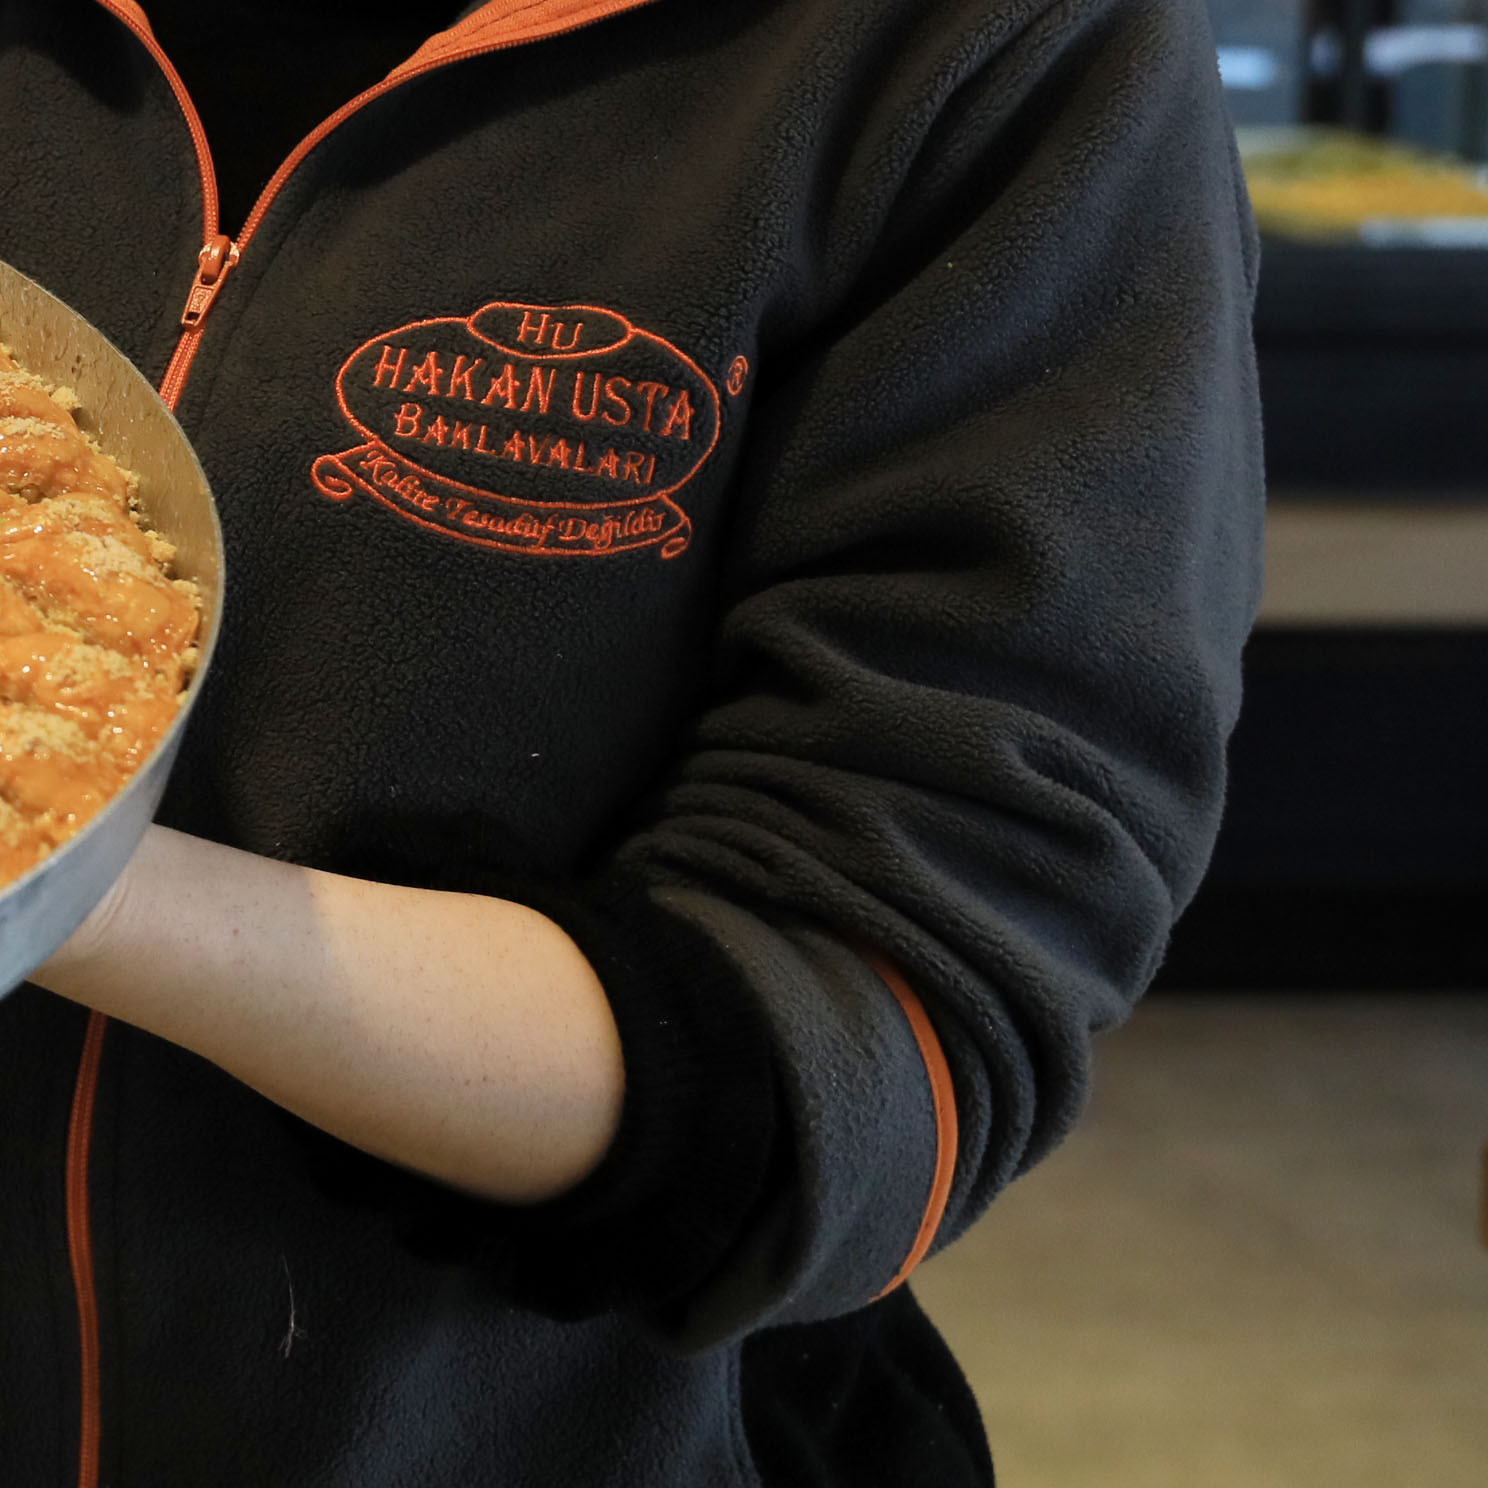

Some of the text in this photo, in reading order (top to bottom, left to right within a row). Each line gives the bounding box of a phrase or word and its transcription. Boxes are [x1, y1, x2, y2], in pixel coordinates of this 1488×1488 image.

[516, 311, 584, 351] HU
[372, 345, 697, 441] HAKAN USTA
[394, 402, 656, 486] BAKLAVALARI
[360, 450, 667, 550] Kalite Tesadüf Değildir
